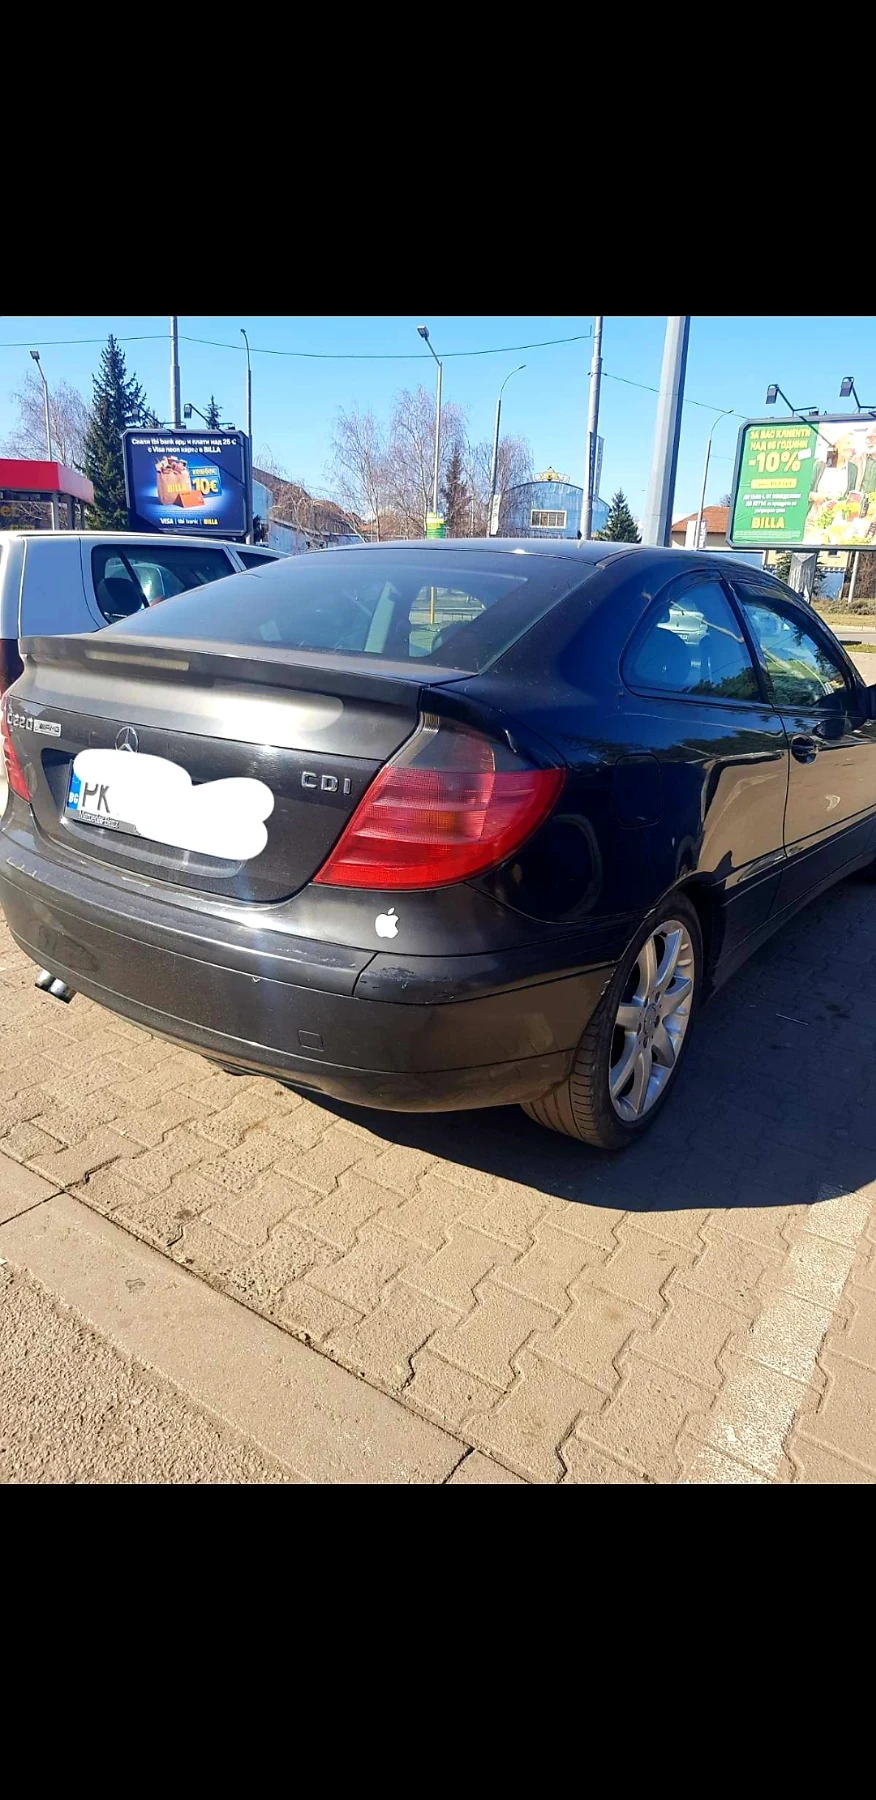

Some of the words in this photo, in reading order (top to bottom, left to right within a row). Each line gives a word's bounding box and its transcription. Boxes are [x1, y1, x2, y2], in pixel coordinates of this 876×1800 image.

[750, 430, 759, 439] ЗА
[776, 428, 811, 438] КЛИЕНТИ
[750, 441, 767, 451] НАД
[777, 440, 808, 451] ГОДИНИ
[748, 451, 801, 473] -10%
[168, 484, 187, 492] BILLA
[751, 516, 785, 529] BILLA
[301, 771, 352, 795] CDI
[69, 792, 79, 804] BG
